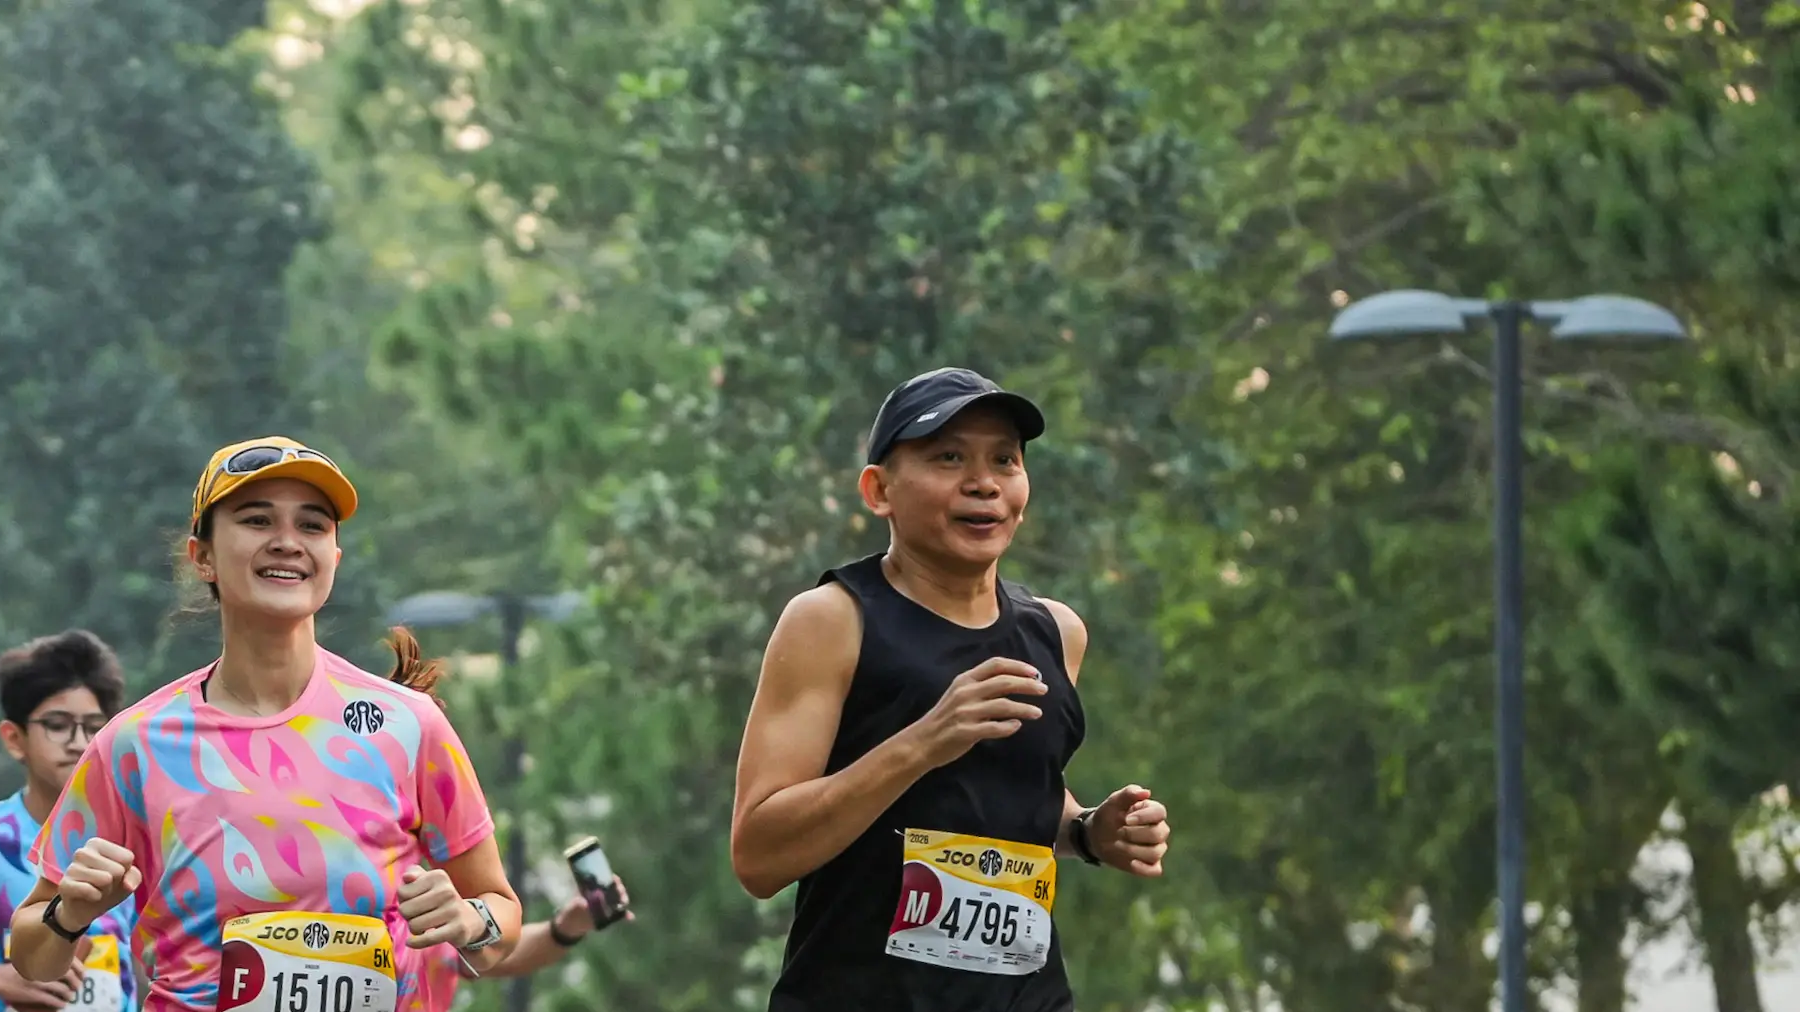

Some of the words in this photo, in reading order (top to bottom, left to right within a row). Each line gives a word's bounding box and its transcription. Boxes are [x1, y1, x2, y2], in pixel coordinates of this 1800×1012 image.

[935, 849, 975, 866] JCO
[1004, 858, 1034, 876] RUN
[1034, 879, 1051, 900] 5K
[903, 890, 930, 924] M
[938, 896, 1020, 948] 4795
[257, 926, 299, 941] JCO
[332, 930, 369, 946] RUN
[373, 948, 392, 969] 5K
[232, 968, 249, 1000] F
